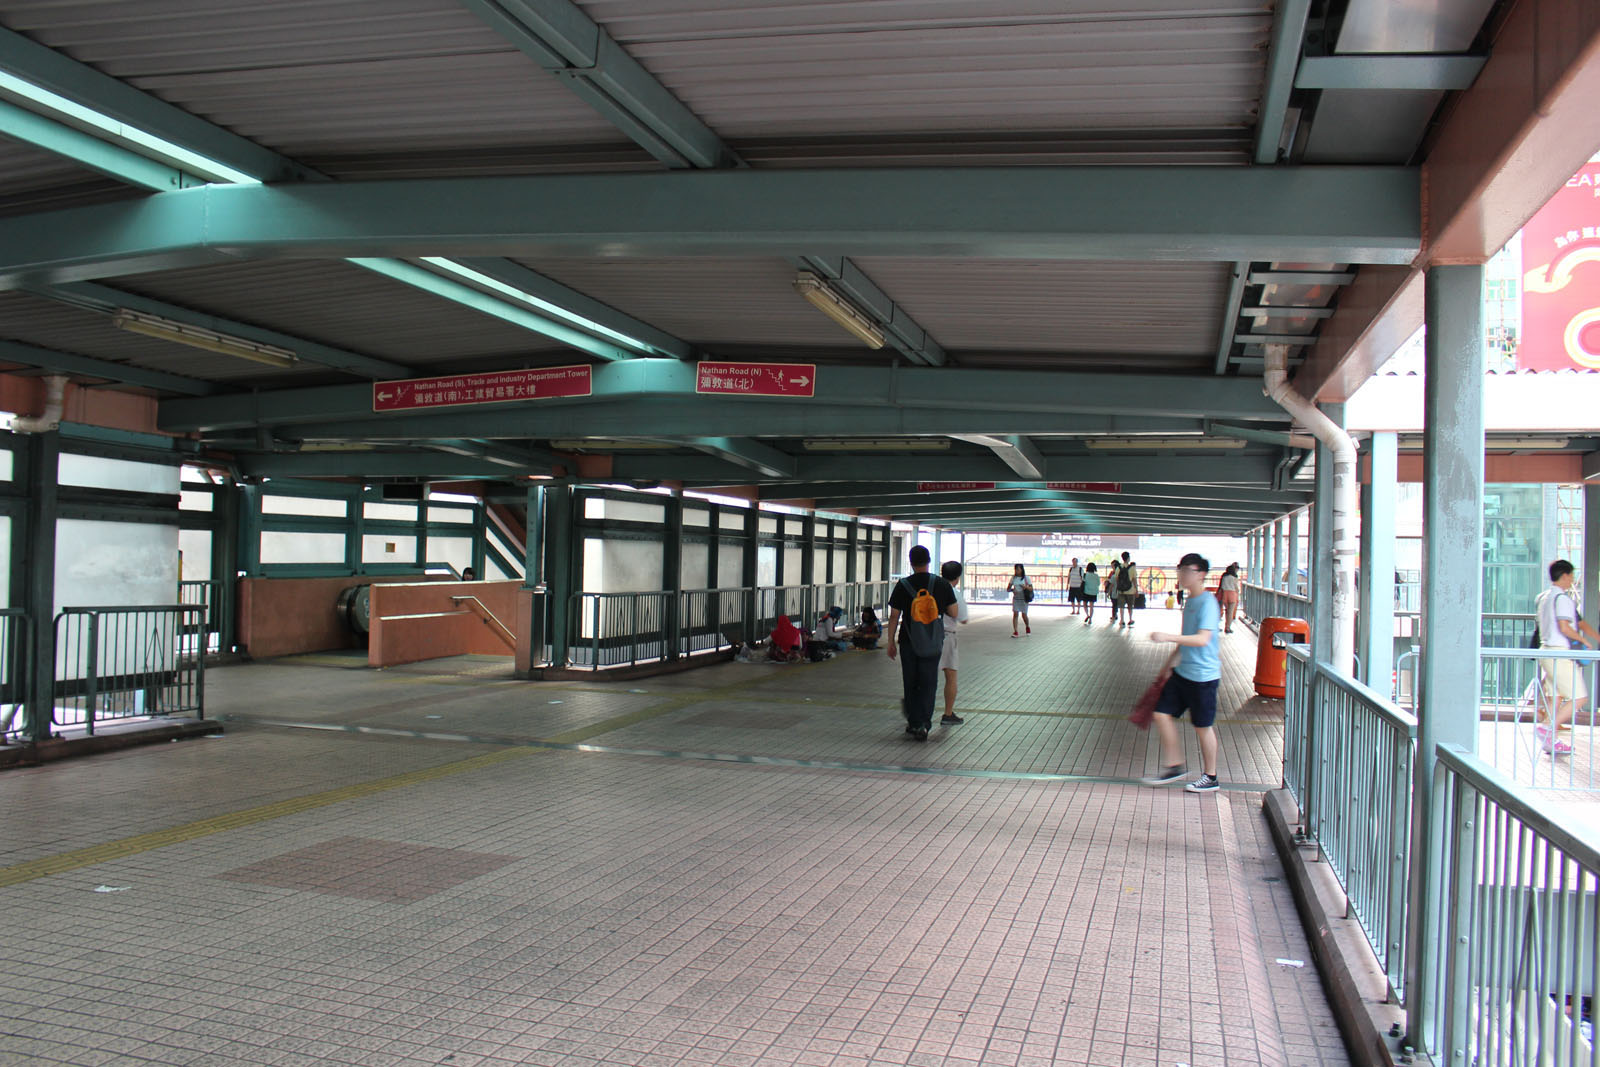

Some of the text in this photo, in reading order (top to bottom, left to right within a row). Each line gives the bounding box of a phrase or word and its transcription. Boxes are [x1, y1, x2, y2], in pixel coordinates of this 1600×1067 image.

[701, 366, 762, 376] Nathan Road (N)
[414, 382, 436, 390] Nathan
[437, 381, 453, 389] Road
[467, 378, 485, 386] Trade
[486, 376, 498, 384] and
[499, 374, 526, 383] Industry
[527, 371, 566, 381] Department
